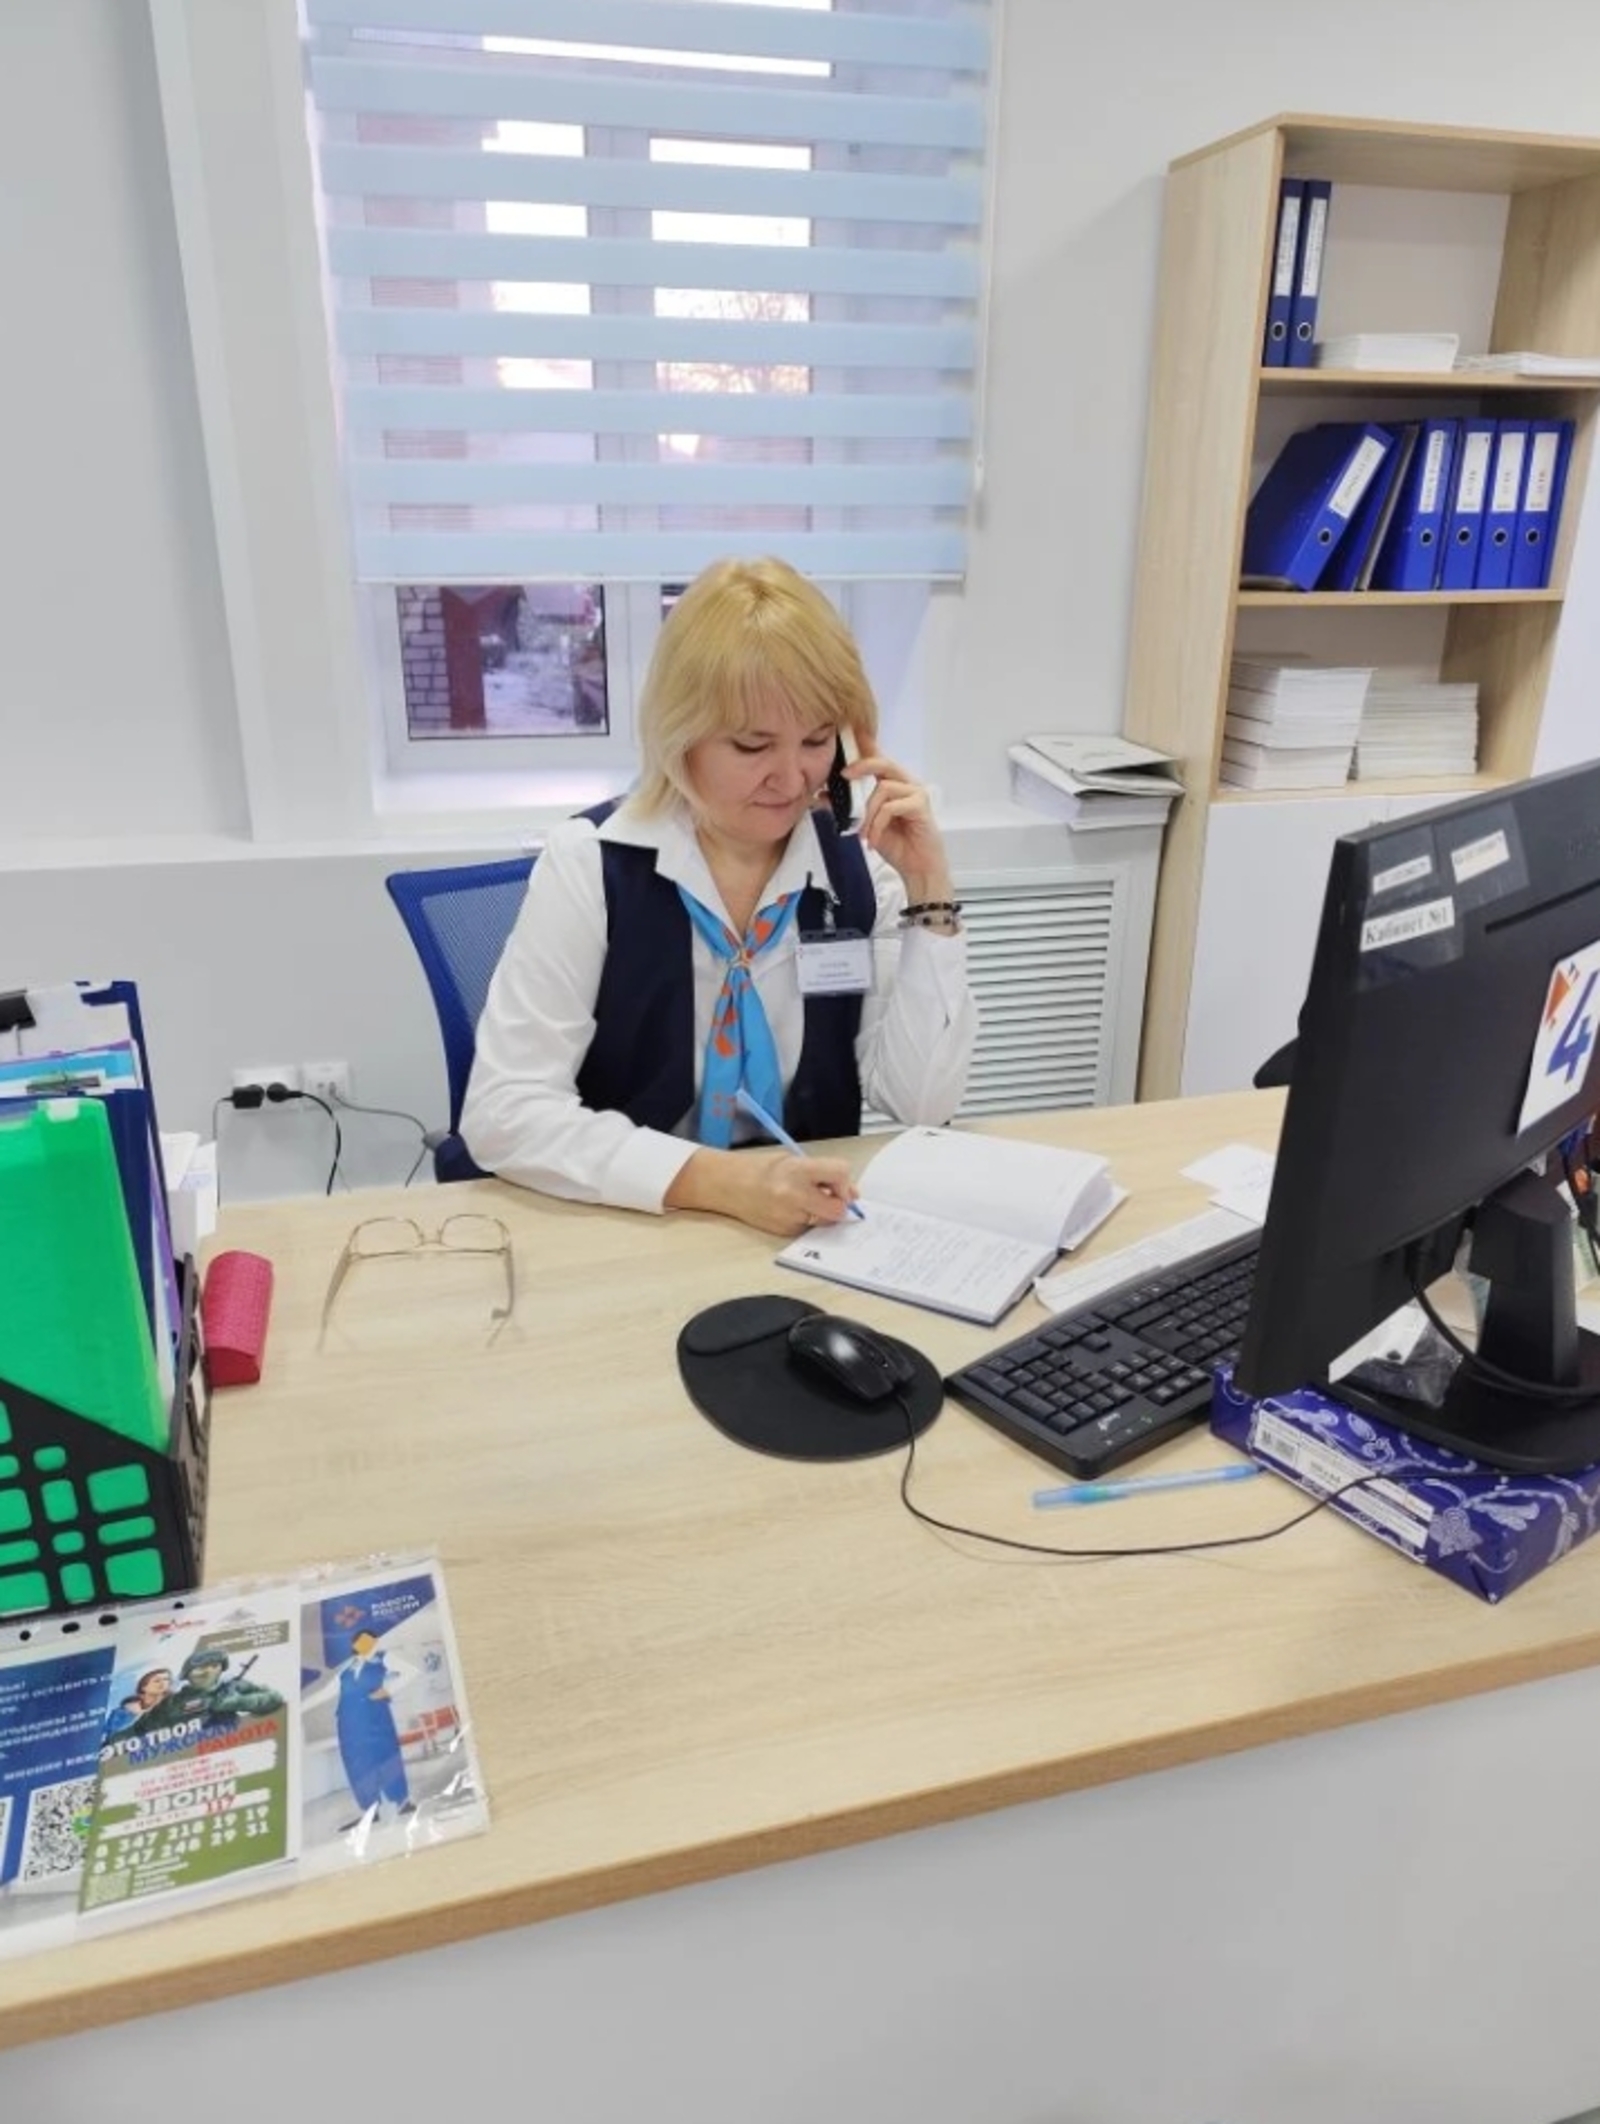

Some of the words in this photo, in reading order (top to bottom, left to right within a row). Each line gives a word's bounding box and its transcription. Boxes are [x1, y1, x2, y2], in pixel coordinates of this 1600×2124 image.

[1365, 915, 1424, 945] Кабинет
[1546, 969, 1600, 1084] 4
[100, 1737, 141, 1762] ЭТО
[145, 1717, 201, 1747] ТВОЯ
[196, 1719, 279, 1756] РАБОТА
[136, 1778, 237, 1818] ЗВОНИ
[206, 1793, 236, 1815] 117
[95, 1844, 109, 1859] 8
[118, 1831, 158, 1853] 347
[212, 1812, 238, 1830] 19
[246, 1804, 269, 1821] 19
[114, 1847, 154, 1870] 347
